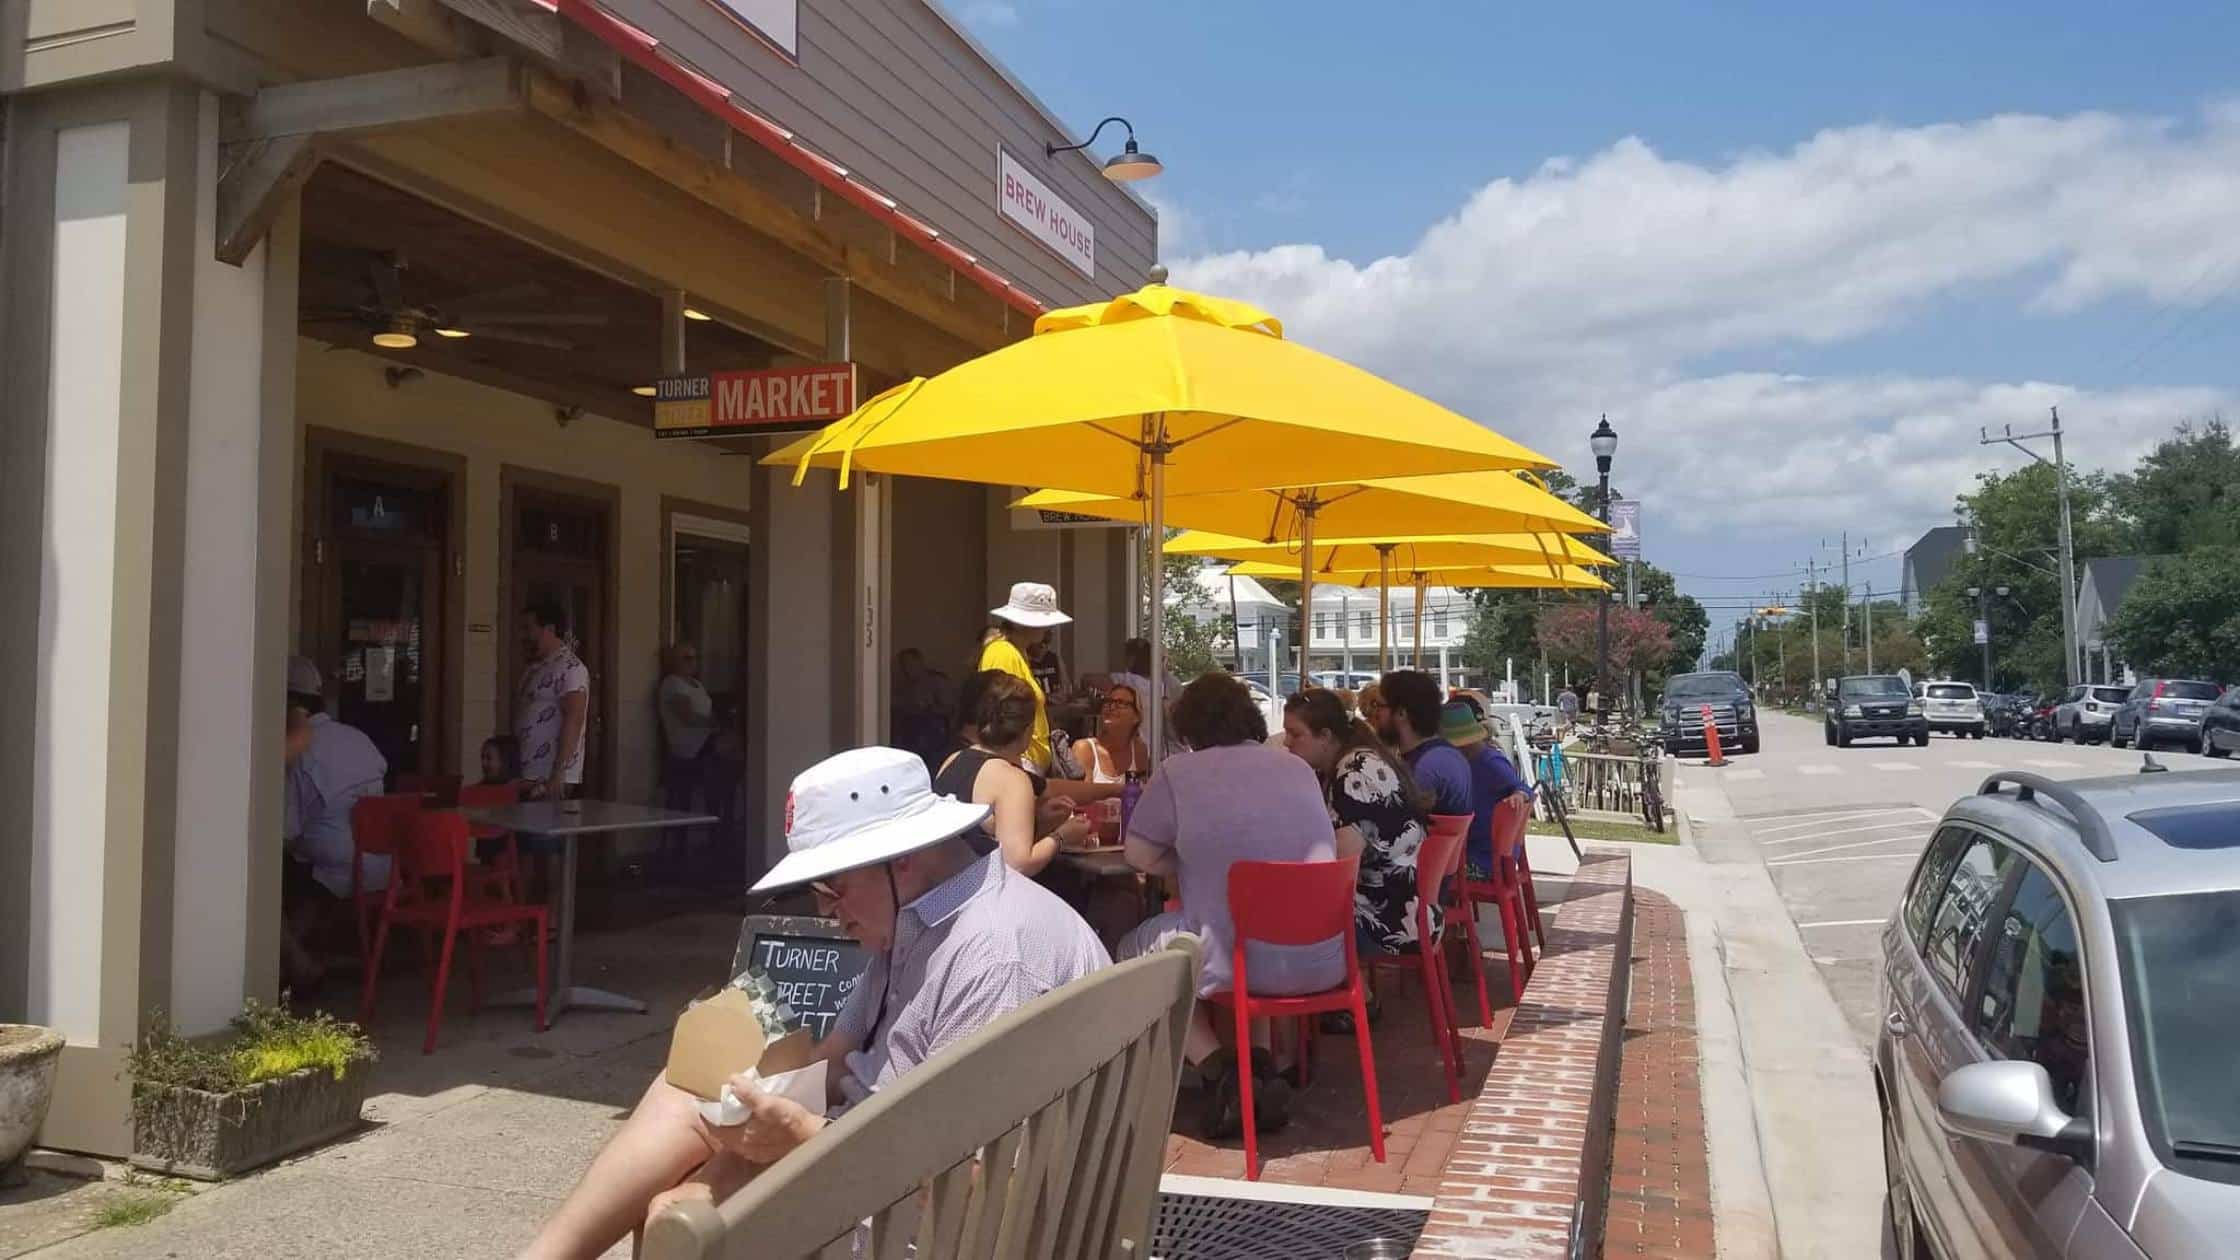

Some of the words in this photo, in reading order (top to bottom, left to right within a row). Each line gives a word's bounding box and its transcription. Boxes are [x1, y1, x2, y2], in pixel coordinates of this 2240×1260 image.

[1006, 173, 1046, 222] BREW
[1050, 208, 1092, 259] HOUSE
[657, 378, 710, 398] TURNER
[717, 372, 849, 421] MARKET
[759, 940, 840, 973] TURNER
